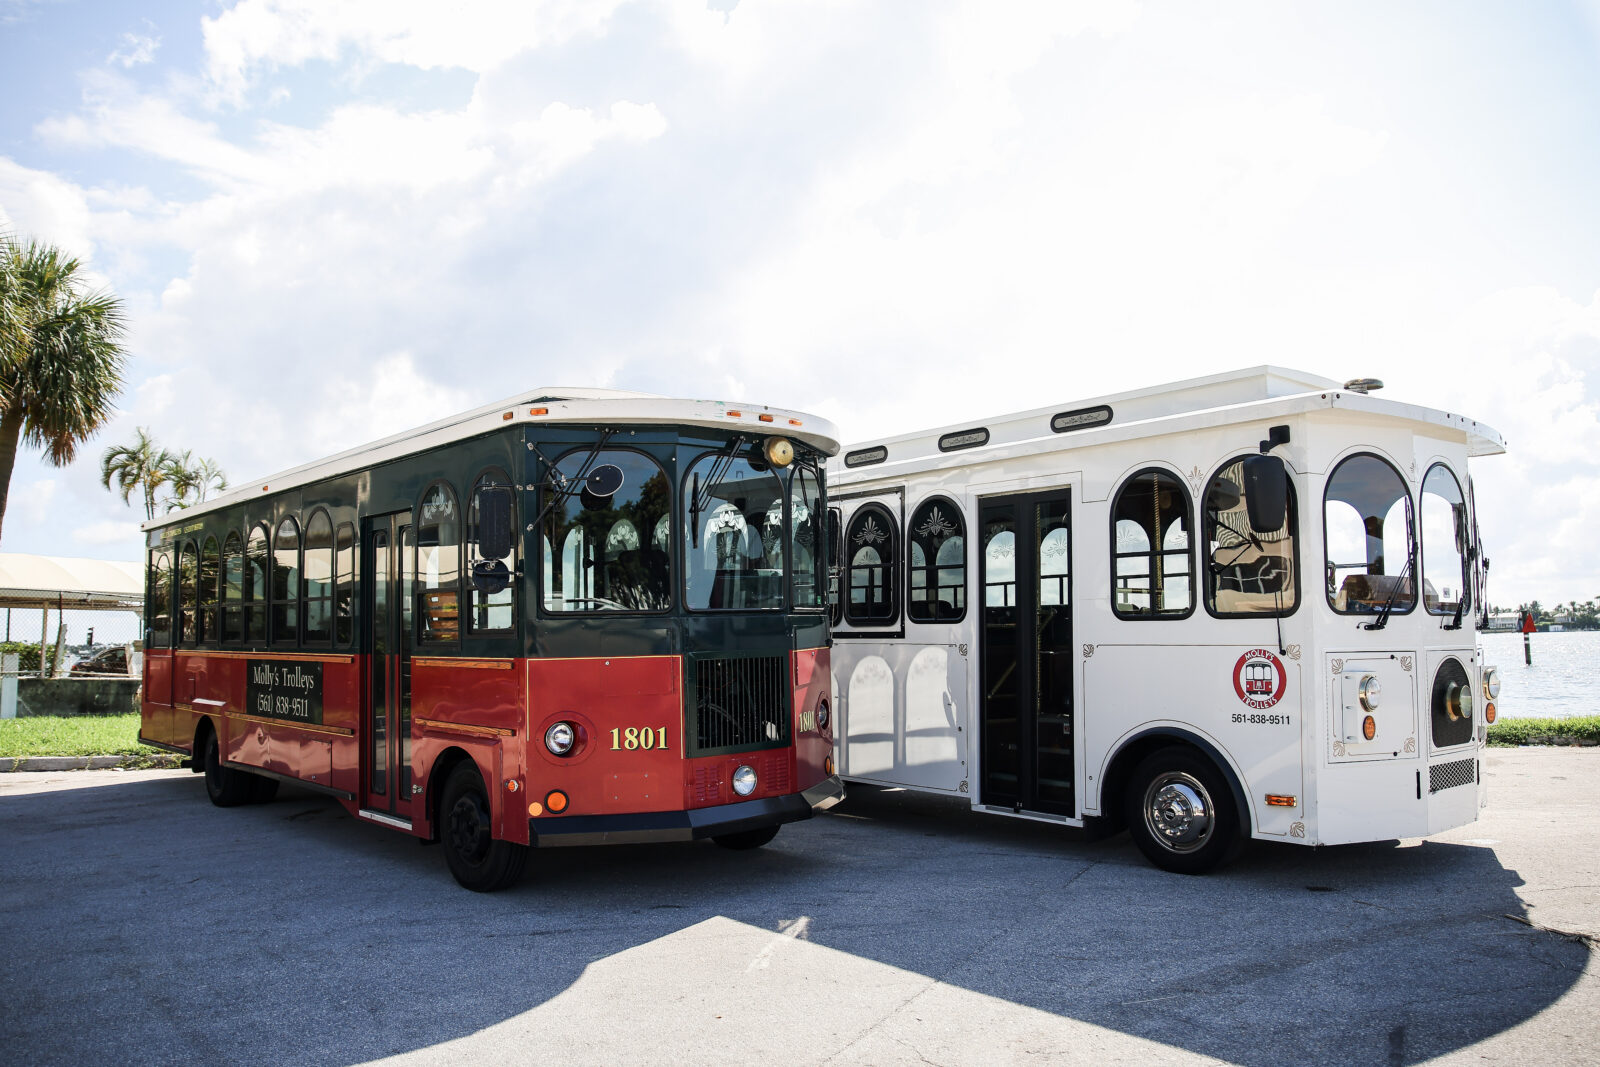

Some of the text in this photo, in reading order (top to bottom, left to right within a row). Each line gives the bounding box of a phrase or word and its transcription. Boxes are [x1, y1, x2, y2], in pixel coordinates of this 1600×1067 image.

[1244, 649, 1275, 662] MOLLY'S
[253, 664, 315, 695] Molly's Trolleys
[257, 692, 308, 717] (561) 838-9511
[1242, 695, 1278, 709] TROLLEYS
[799, 710, 815, 733] 1801
[1231, 713, 1290, 725] 561-838-9511
[609, 726, 669, 751] 1801
